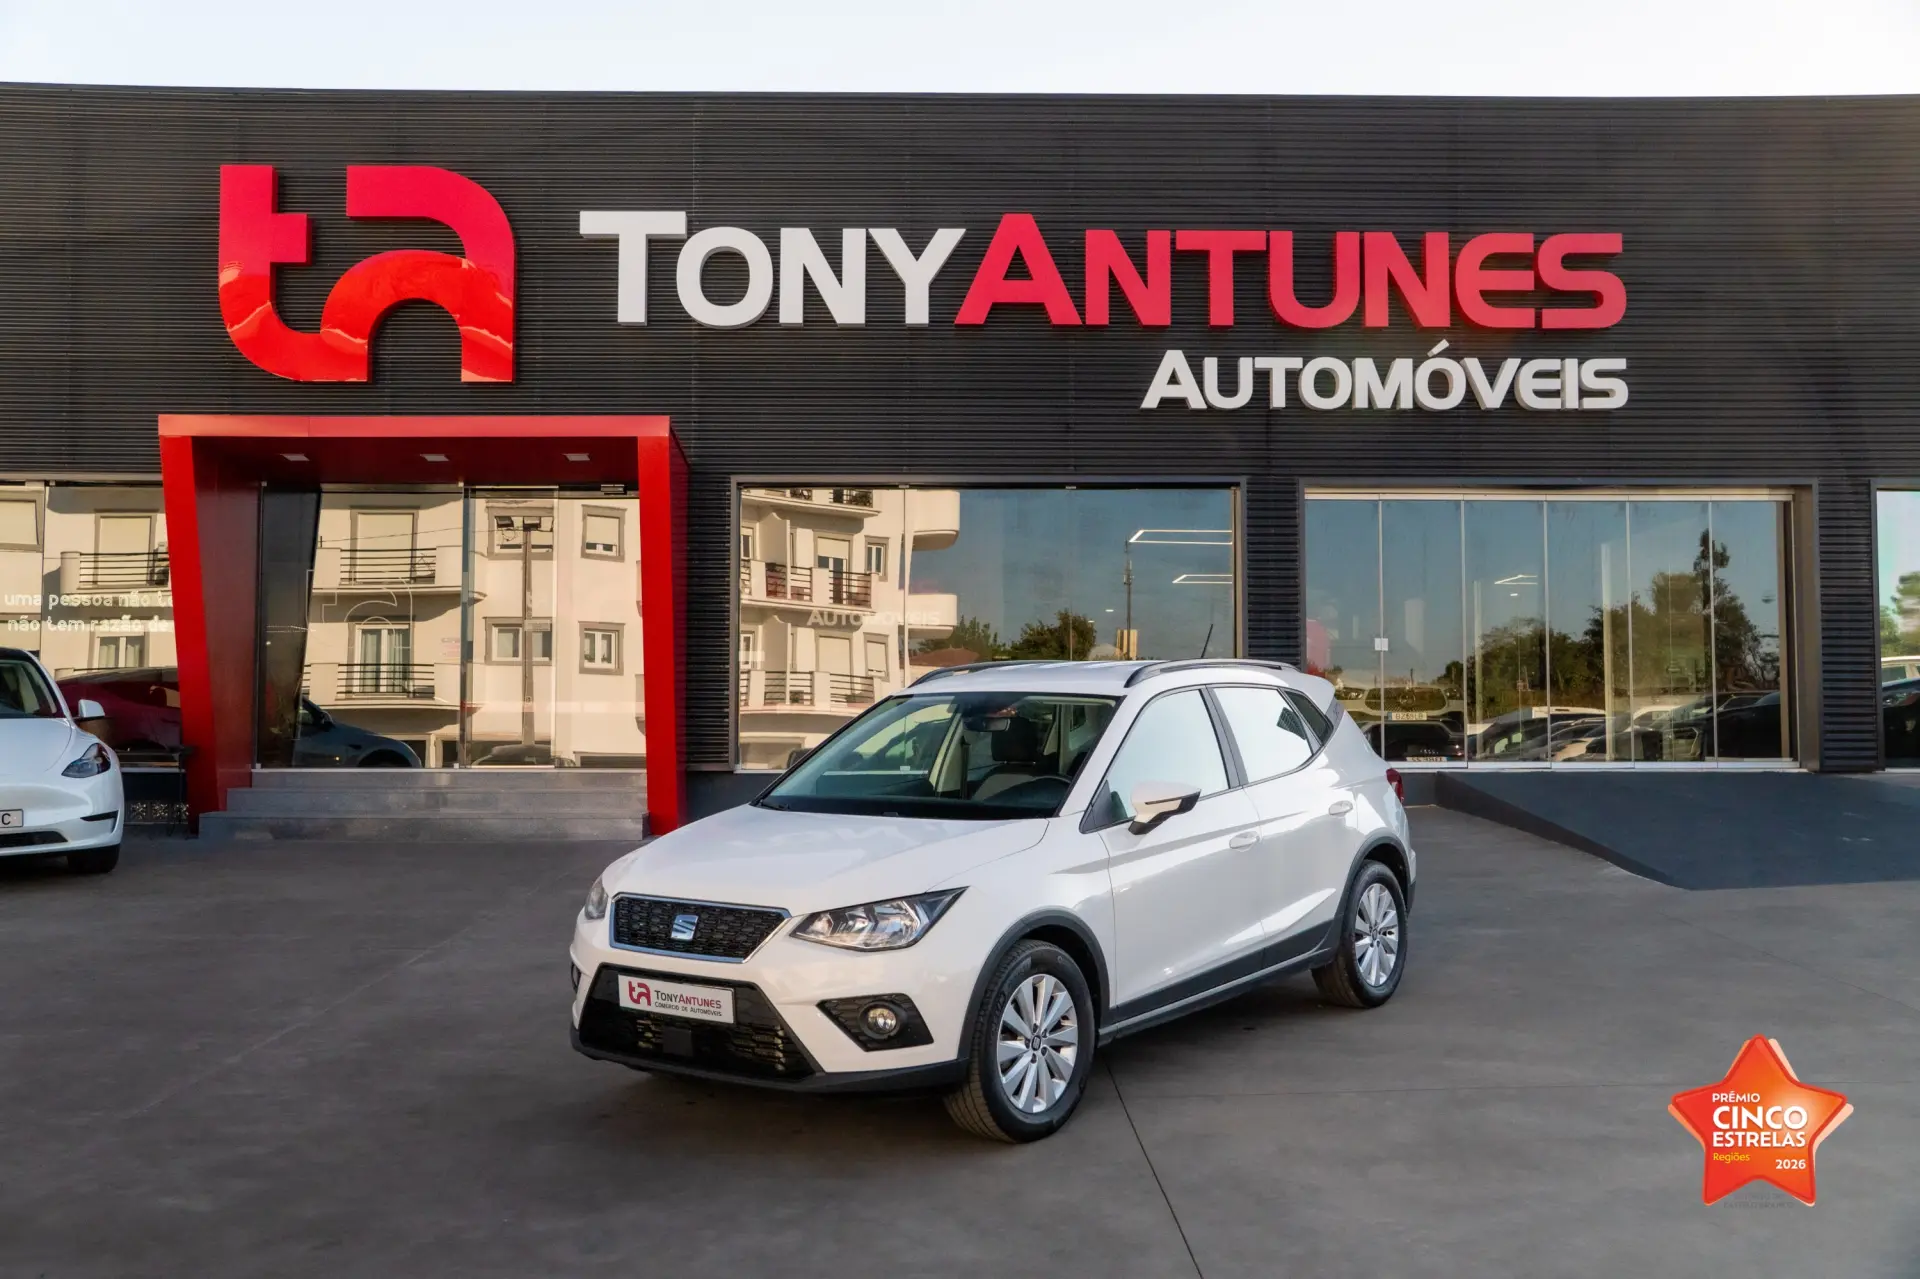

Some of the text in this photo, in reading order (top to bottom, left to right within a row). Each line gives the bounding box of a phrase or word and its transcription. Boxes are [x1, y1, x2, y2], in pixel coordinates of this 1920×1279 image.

[1140, 339, 1629, 411] AUTOMÓVEIS
[4, 593, 42, 606] uma
[48, 594, 113, 610] pessoa
[118, 590, 151, 607] não
[7, 615, 40, 632] não
[47, 616, 85, 631] tem
[90, 614, 143, 632] razão
